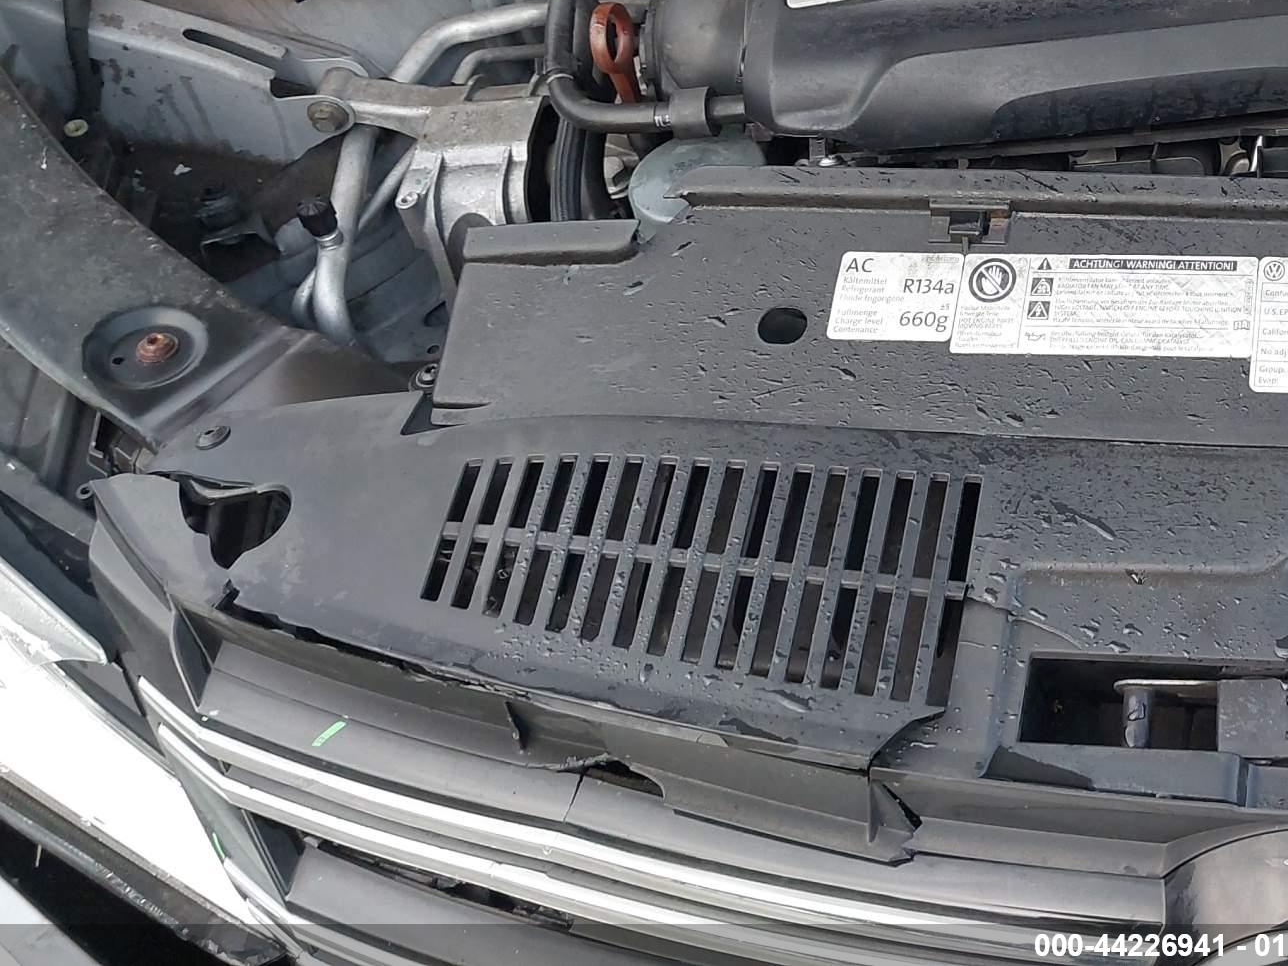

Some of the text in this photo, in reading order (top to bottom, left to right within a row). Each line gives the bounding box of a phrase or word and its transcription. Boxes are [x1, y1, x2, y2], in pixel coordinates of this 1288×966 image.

[845, 258, 874, 273] AC
[1073, 259, 1234, 271] ACHTUNG! WARNING! ATTENTION!
[903, 278, 954, 294] R134a
[899, 311, 948, 333] 660g
[1260, 347, 1273, 355] No
